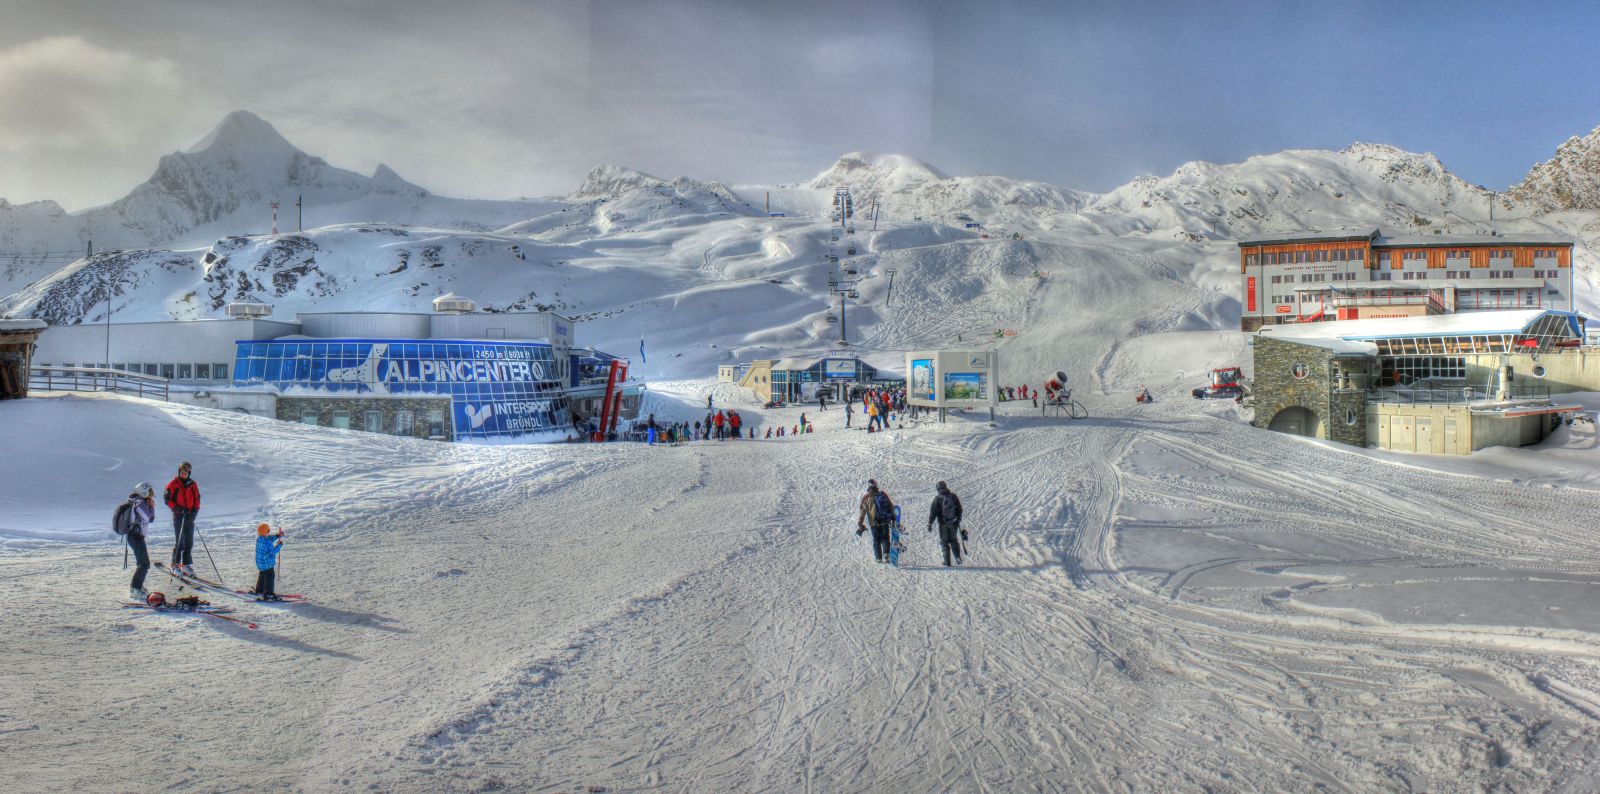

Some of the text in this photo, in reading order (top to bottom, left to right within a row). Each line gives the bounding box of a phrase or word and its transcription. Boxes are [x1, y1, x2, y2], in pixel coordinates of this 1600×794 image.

[475, 350, 495, 359] 2450
[508, 350, 524, 359] 8038
[385, 360, 532, 382] ALPINCENTER
[494, 401, 551, 415] INTERSPORT
